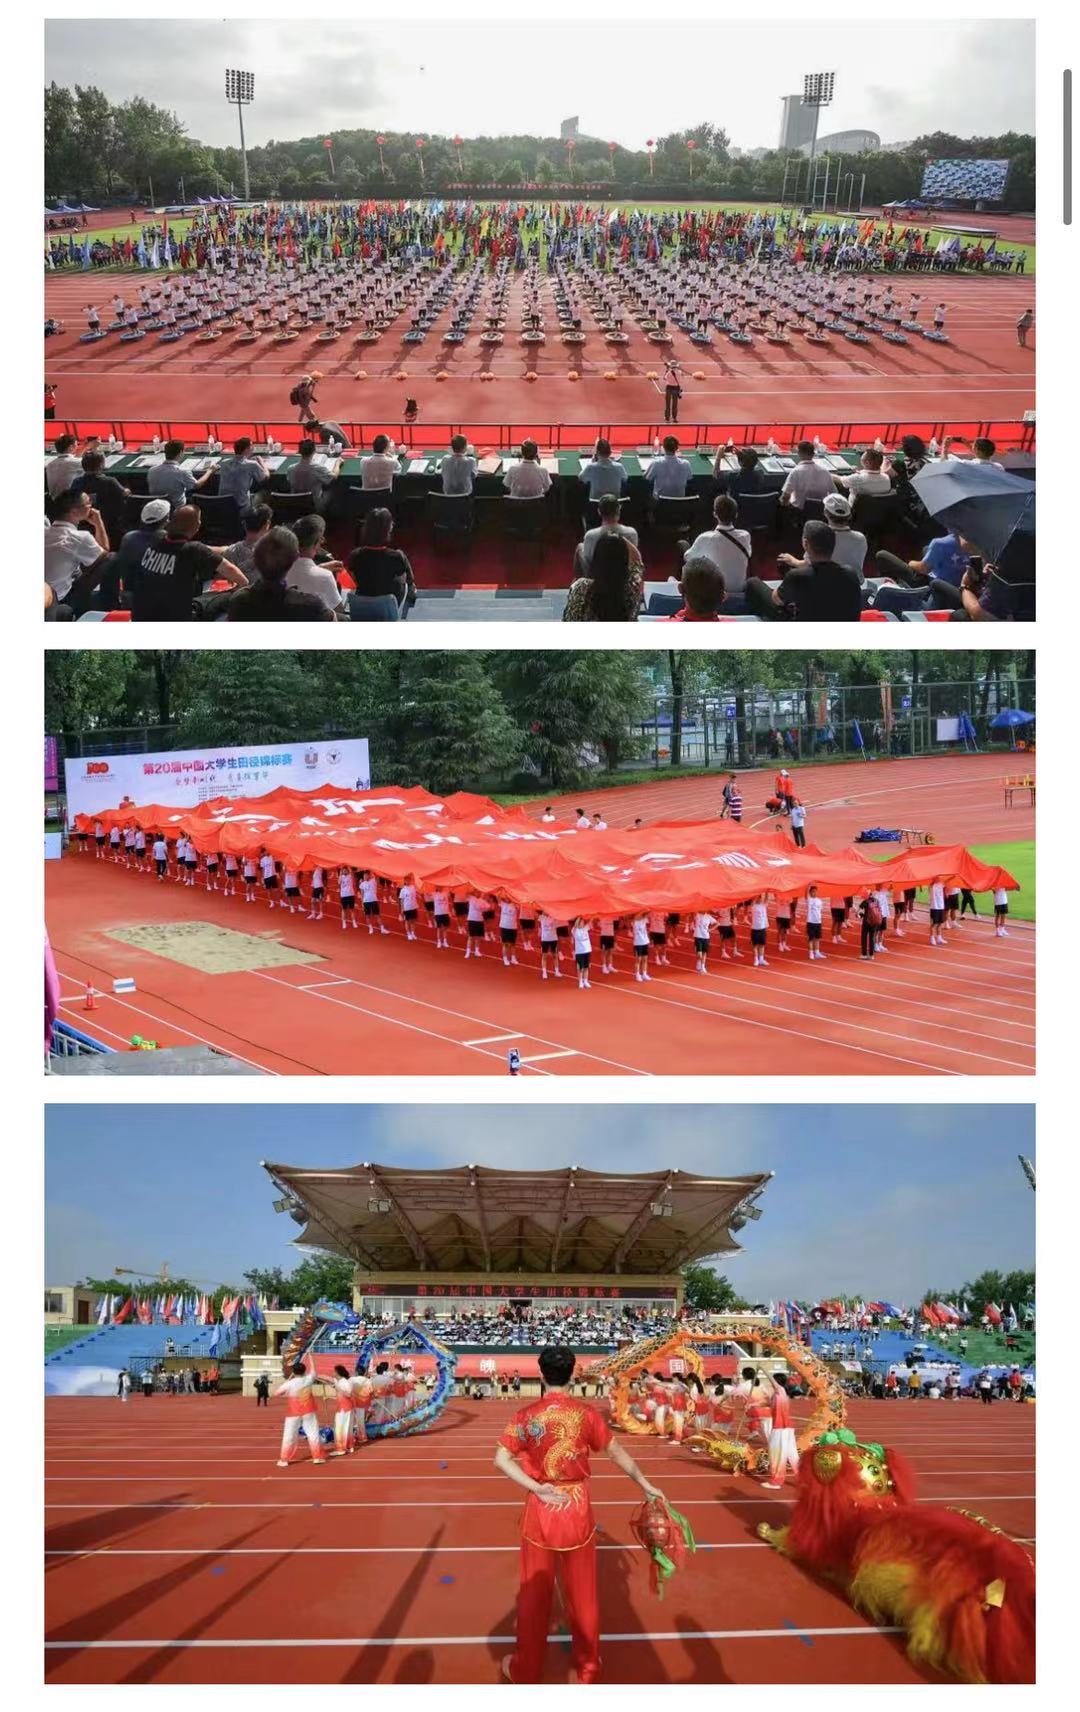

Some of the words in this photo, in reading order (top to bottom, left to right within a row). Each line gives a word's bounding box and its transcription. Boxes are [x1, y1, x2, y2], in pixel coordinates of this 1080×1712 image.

[141, 547, 176, 575] CHINA
[143, 753, 294, 776] 第20届中国大学生田径锦标赛
[669, 1358, 685, 1374] 国
